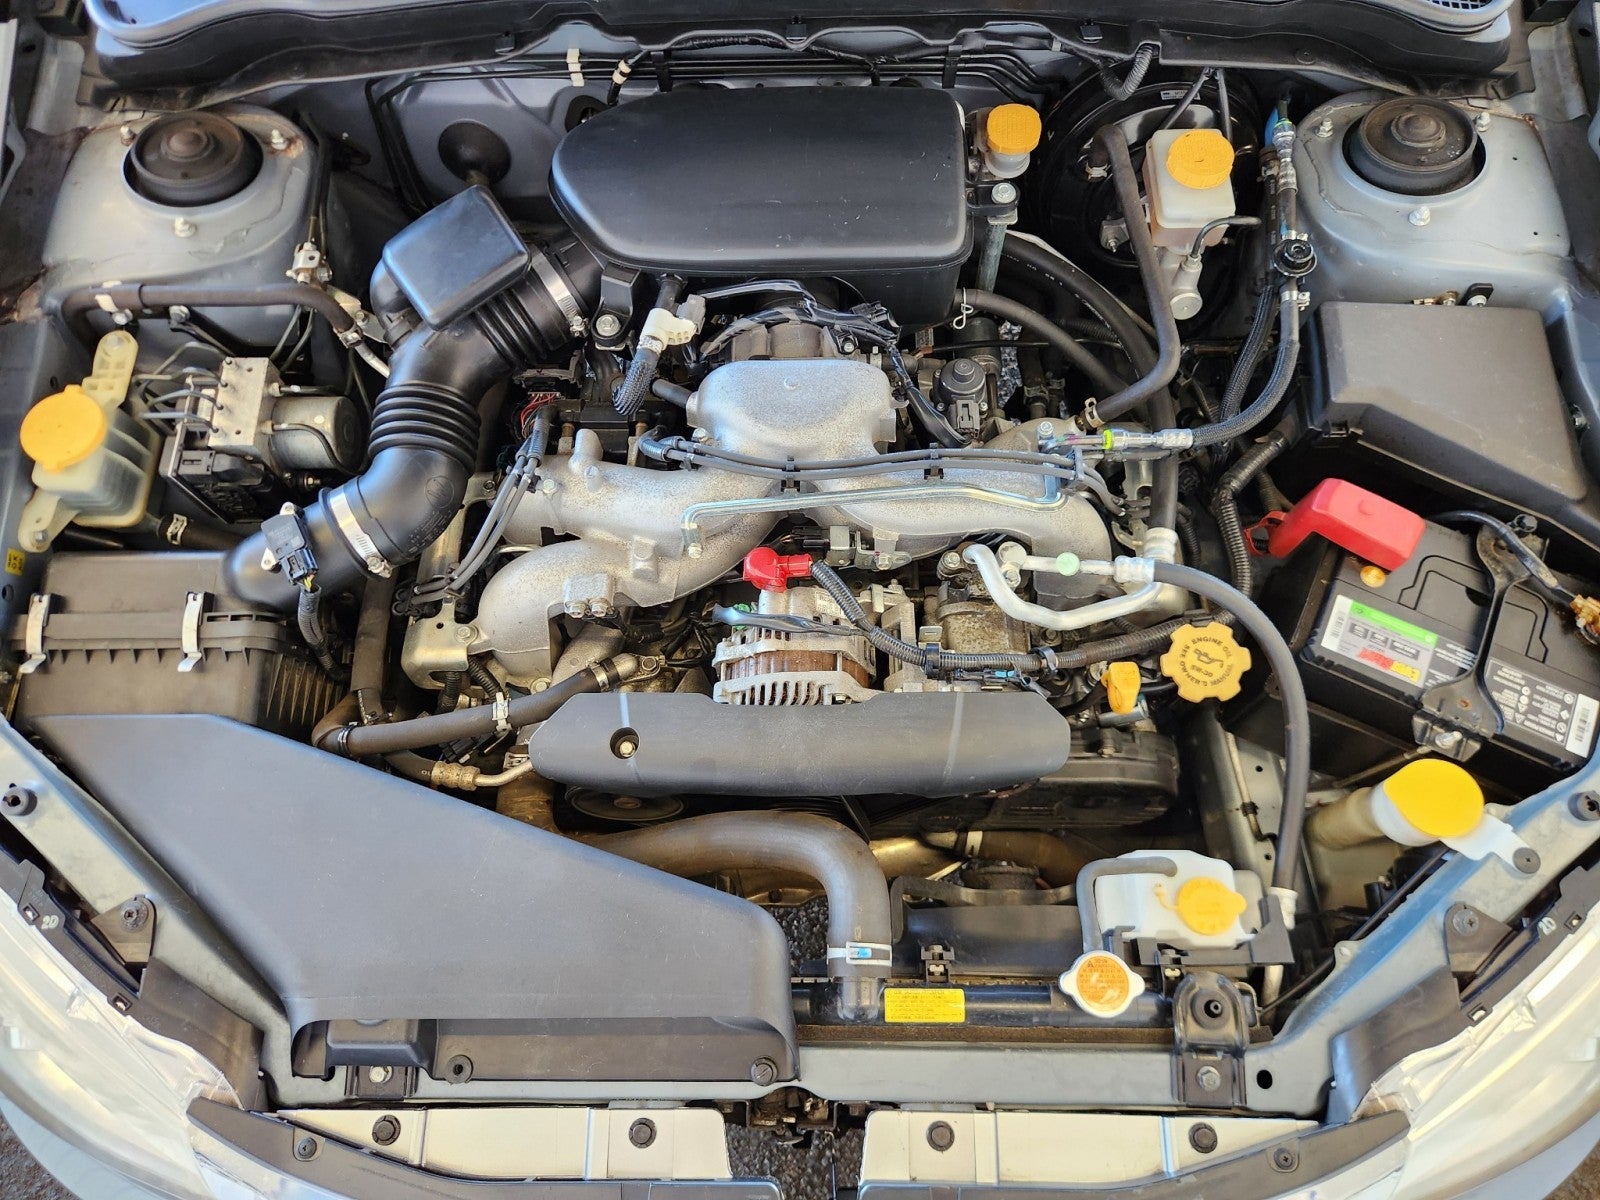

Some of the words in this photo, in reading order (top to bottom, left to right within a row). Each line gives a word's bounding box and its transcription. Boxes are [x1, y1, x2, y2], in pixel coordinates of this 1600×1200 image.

[1191, 636, 1223, 645] ENGINE
[1223, 646, 1232, 660] OIL
[41, 914, 59, 930] 2D
[1538, 916, 1557, 935] 2D
